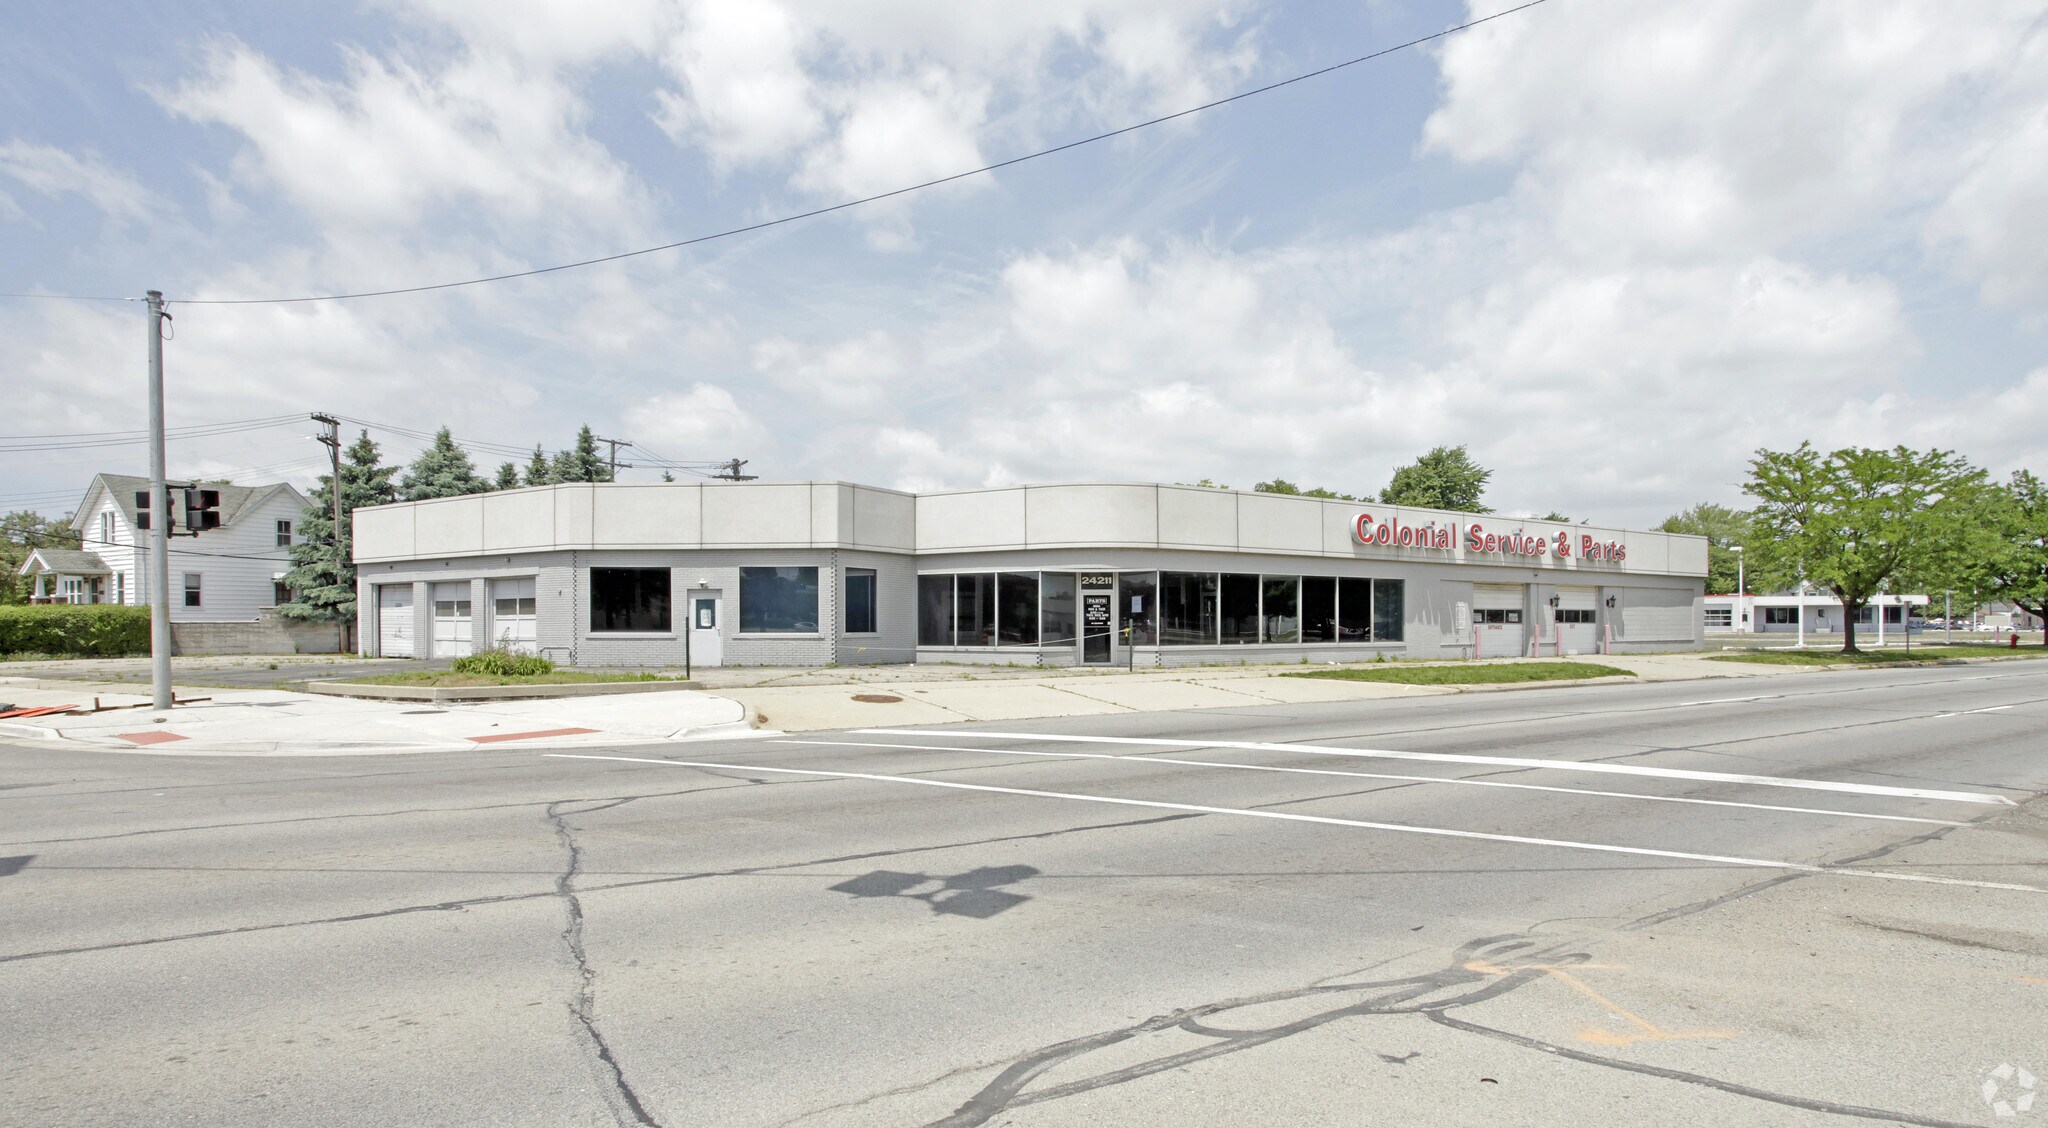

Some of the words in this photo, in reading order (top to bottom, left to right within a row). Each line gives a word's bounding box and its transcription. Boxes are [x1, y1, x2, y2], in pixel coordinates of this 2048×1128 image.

[1355, 513, 1457, 549] Colonial
[1469, 523, 1546, 555] Service
[1557, 530, 1571, 557] &
[1581, 534, 1626, 561] Parts
[1081, 576, 1112, 584] 24211
